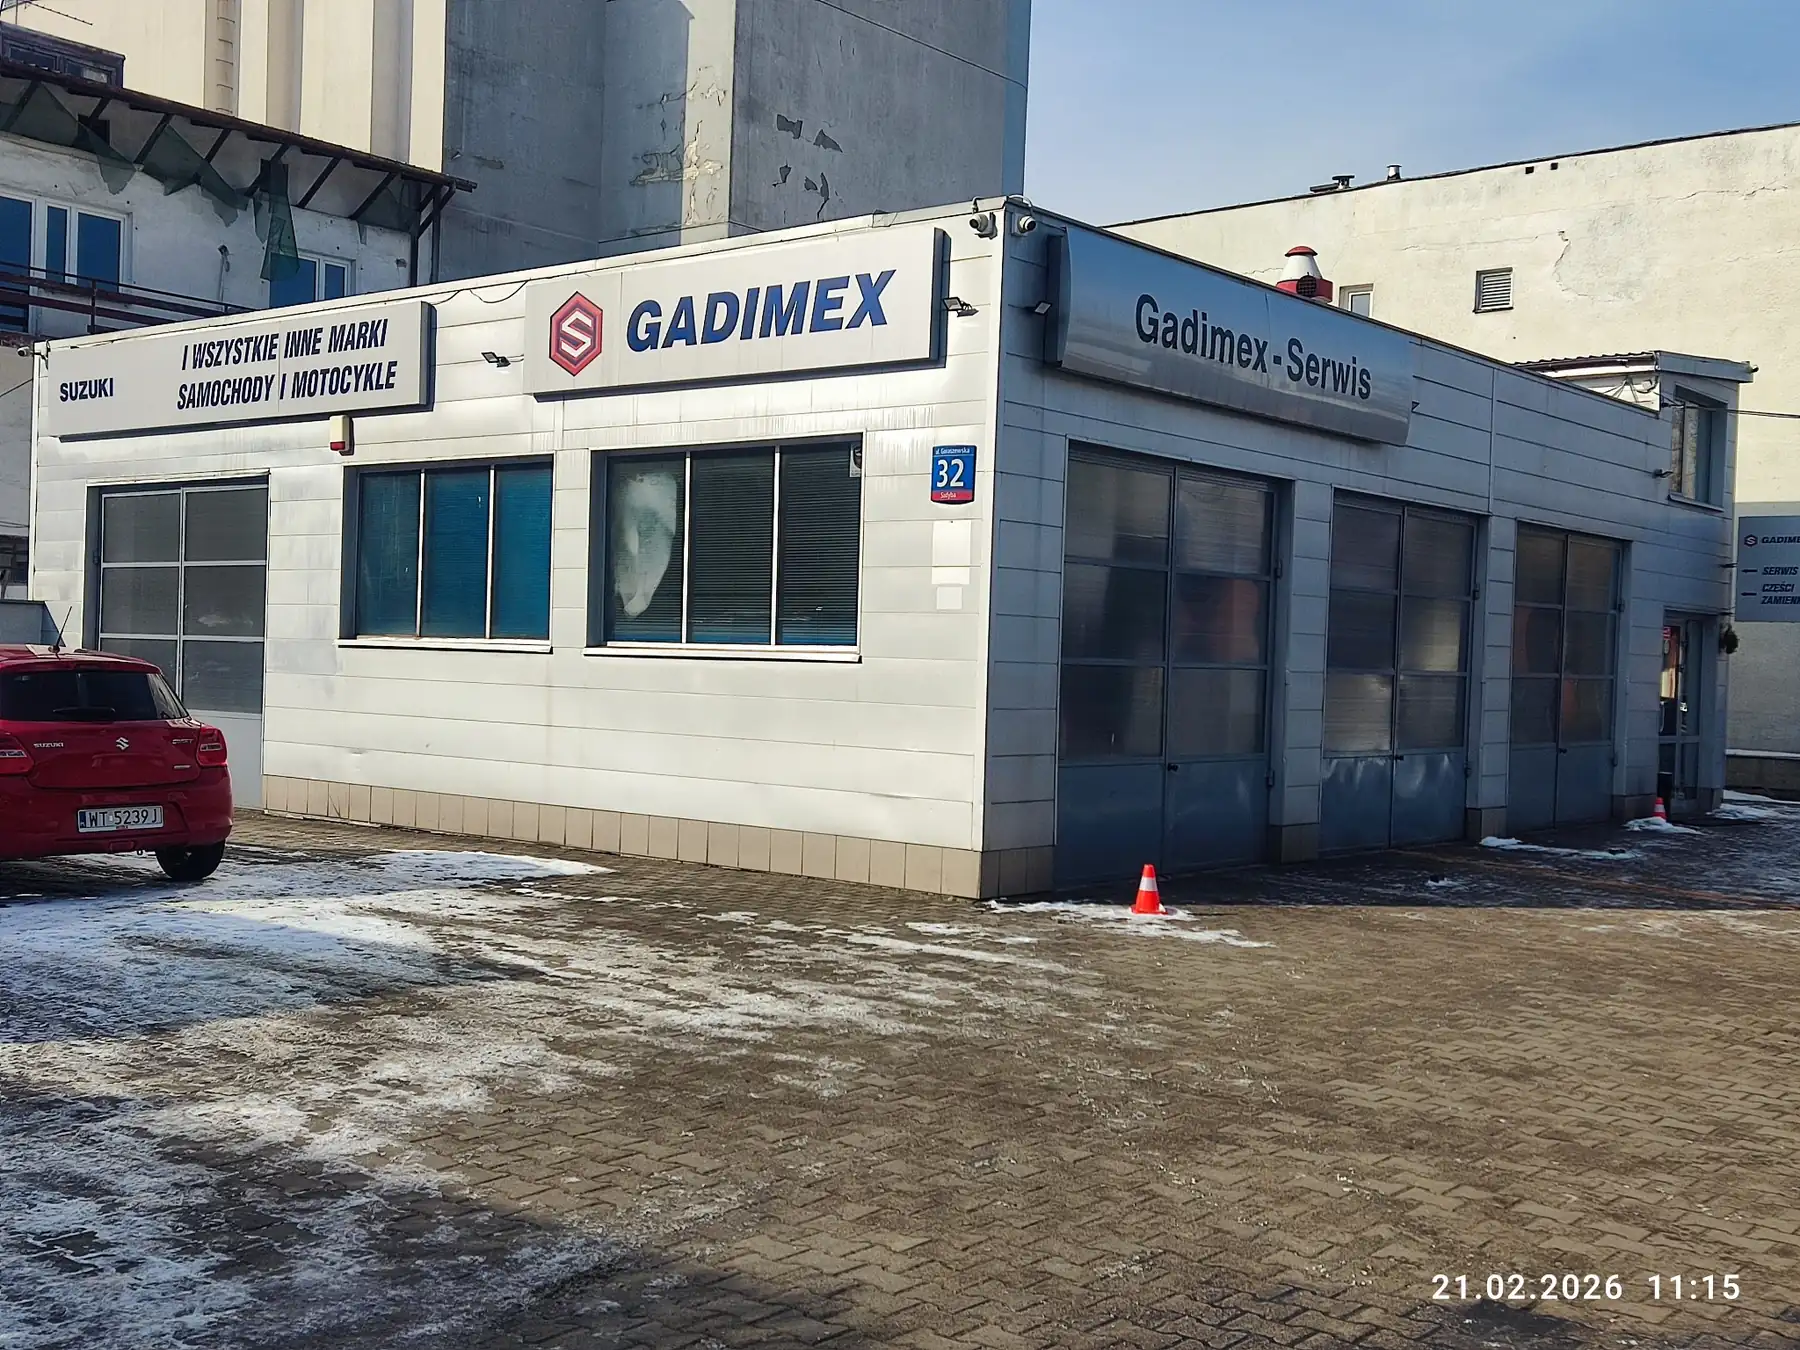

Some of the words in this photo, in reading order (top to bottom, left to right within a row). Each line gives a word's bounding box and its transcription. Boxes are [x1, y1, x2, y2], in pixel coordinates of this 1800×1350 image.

[626, 269, 897, 352] GADIMEX
[182, 345, 190, 371] I
[191, 333, 278, 369] WSZYSTKIE
[284, 327, 323, 359] INNE
[328, 318, 389, 354] MARKI
[1135, 293, 1371, 400] Gadimex-Serwis
[59, 377, 114, 402] SUZUKI
[177, 376, 273, 410] SAMOCHODY
[279, 374, 287, 400] I
[291, 360, 398, 399] MOTOCYKLE
[936, 458, 963, 487] 32
[1762, 566, 1799, 576] SERWIS
[1761, 580, 1795, 593] CZĘŚCI
[89, 811, 108, 827] WT
